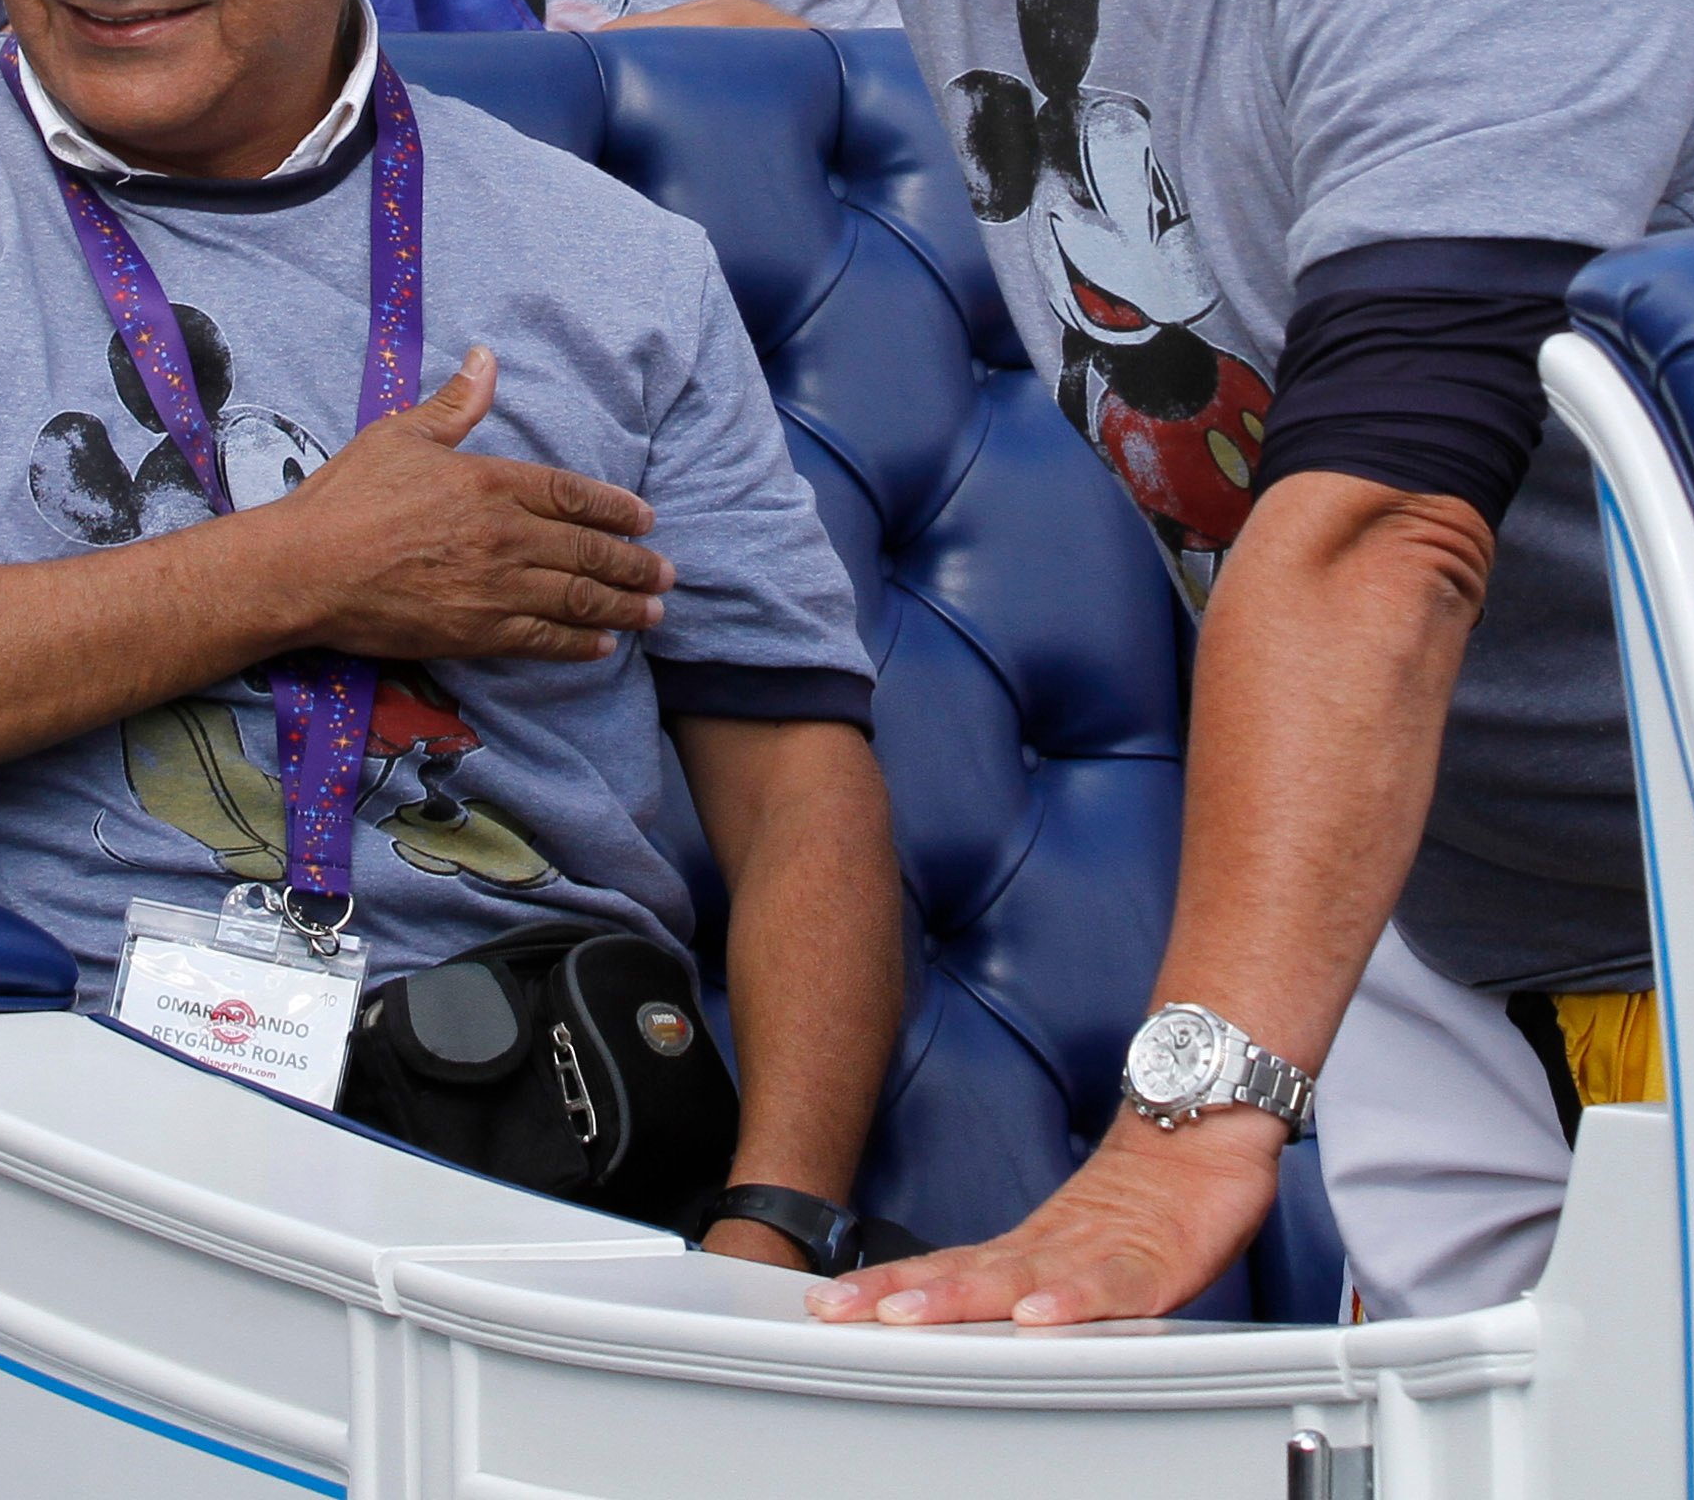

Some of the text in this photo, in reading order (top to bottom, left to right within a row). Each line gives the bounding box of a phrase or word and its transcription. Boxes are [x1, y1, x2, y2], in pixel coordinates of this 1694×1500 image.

[157, 994, 214, 1021] OMAR
[151, 1024, 247, 1057] REYGADAS
[252, 1044, 309, 1071] ROJAS
